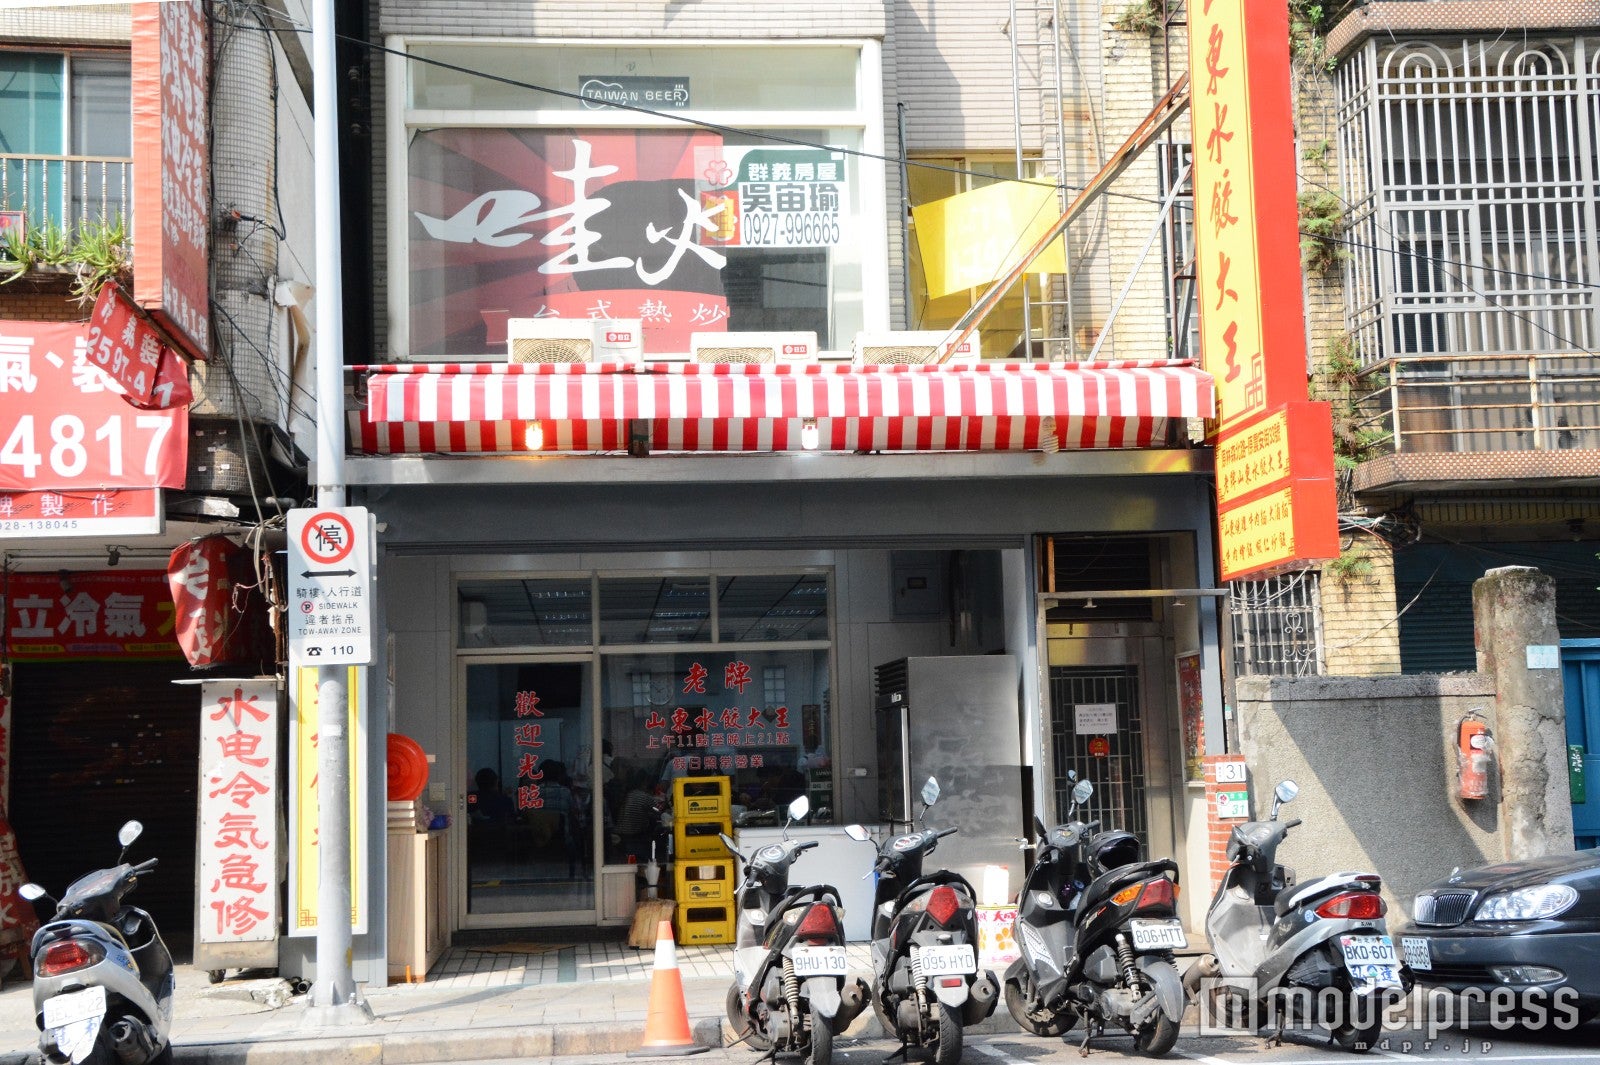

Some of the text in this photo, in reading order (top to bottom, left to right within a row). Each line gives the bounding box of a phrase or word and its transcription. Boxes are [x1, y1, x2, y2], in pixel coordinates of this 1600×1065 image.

[587, 89, 683, 101] TAIWAN BEER
[748, 163, 837, 181] 群義房屋
[1202, 0, 1241, 383] 東水餃大王
[744, 213, 840, 245] 0927-996665
[0, 414, 173, 478] 4817
[315, 525, 343, 552] 停
[0, 592, 147, 638] 立冷氣
[319, 602, 358, 610] SIDEWALK
[341, 626, 362, 634] ZONE
[331, 645, 354, 655] 110
[683, 661, 752, 694] 老牌
[645, 706, 791, 733] 山東水餃大王
[514, 690, 545, 809] 歡迎光臨
[1226, 764, 1244, 779] 31
